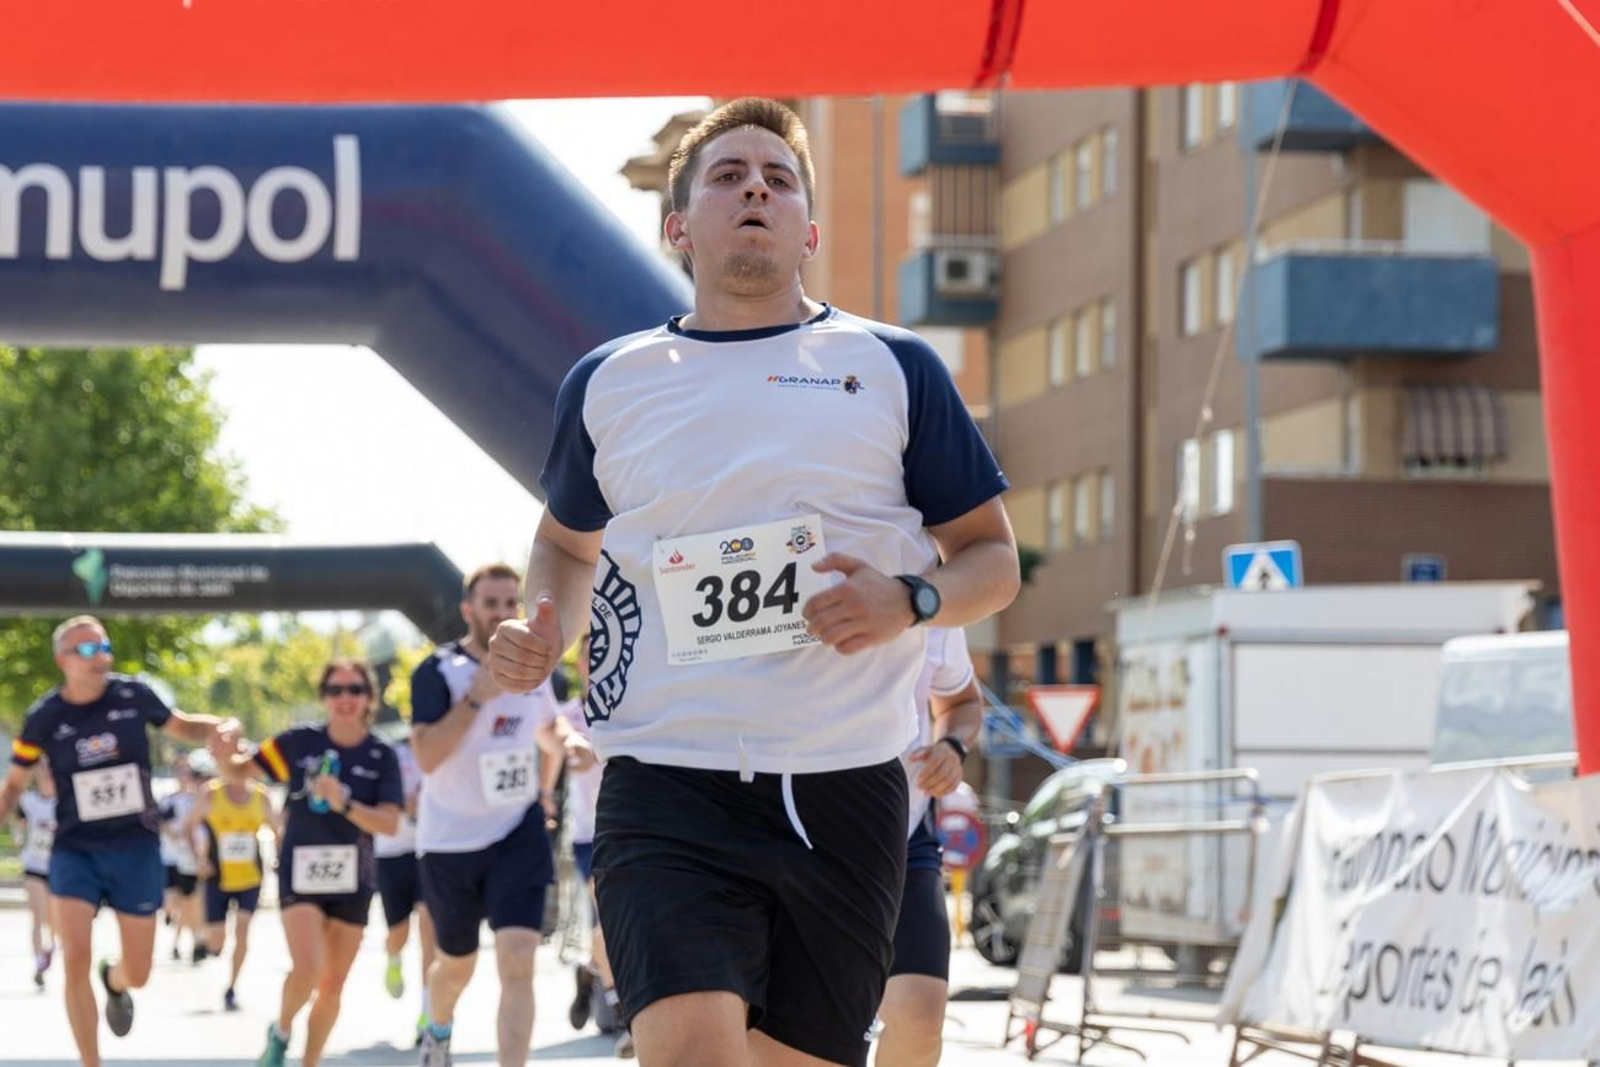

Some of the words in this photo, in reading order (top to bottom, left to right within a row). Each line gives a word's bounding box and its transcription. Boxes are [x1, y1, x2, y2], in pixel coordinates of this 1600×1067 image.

[0, 134, 361, 291] mupol
[692, 562, 799, 628] 384
[697, 633, 722, 646] SERGIO
[723, 626, 772, 641] VALDERRAMA
[773, 620, 807, 634] JOYANES
